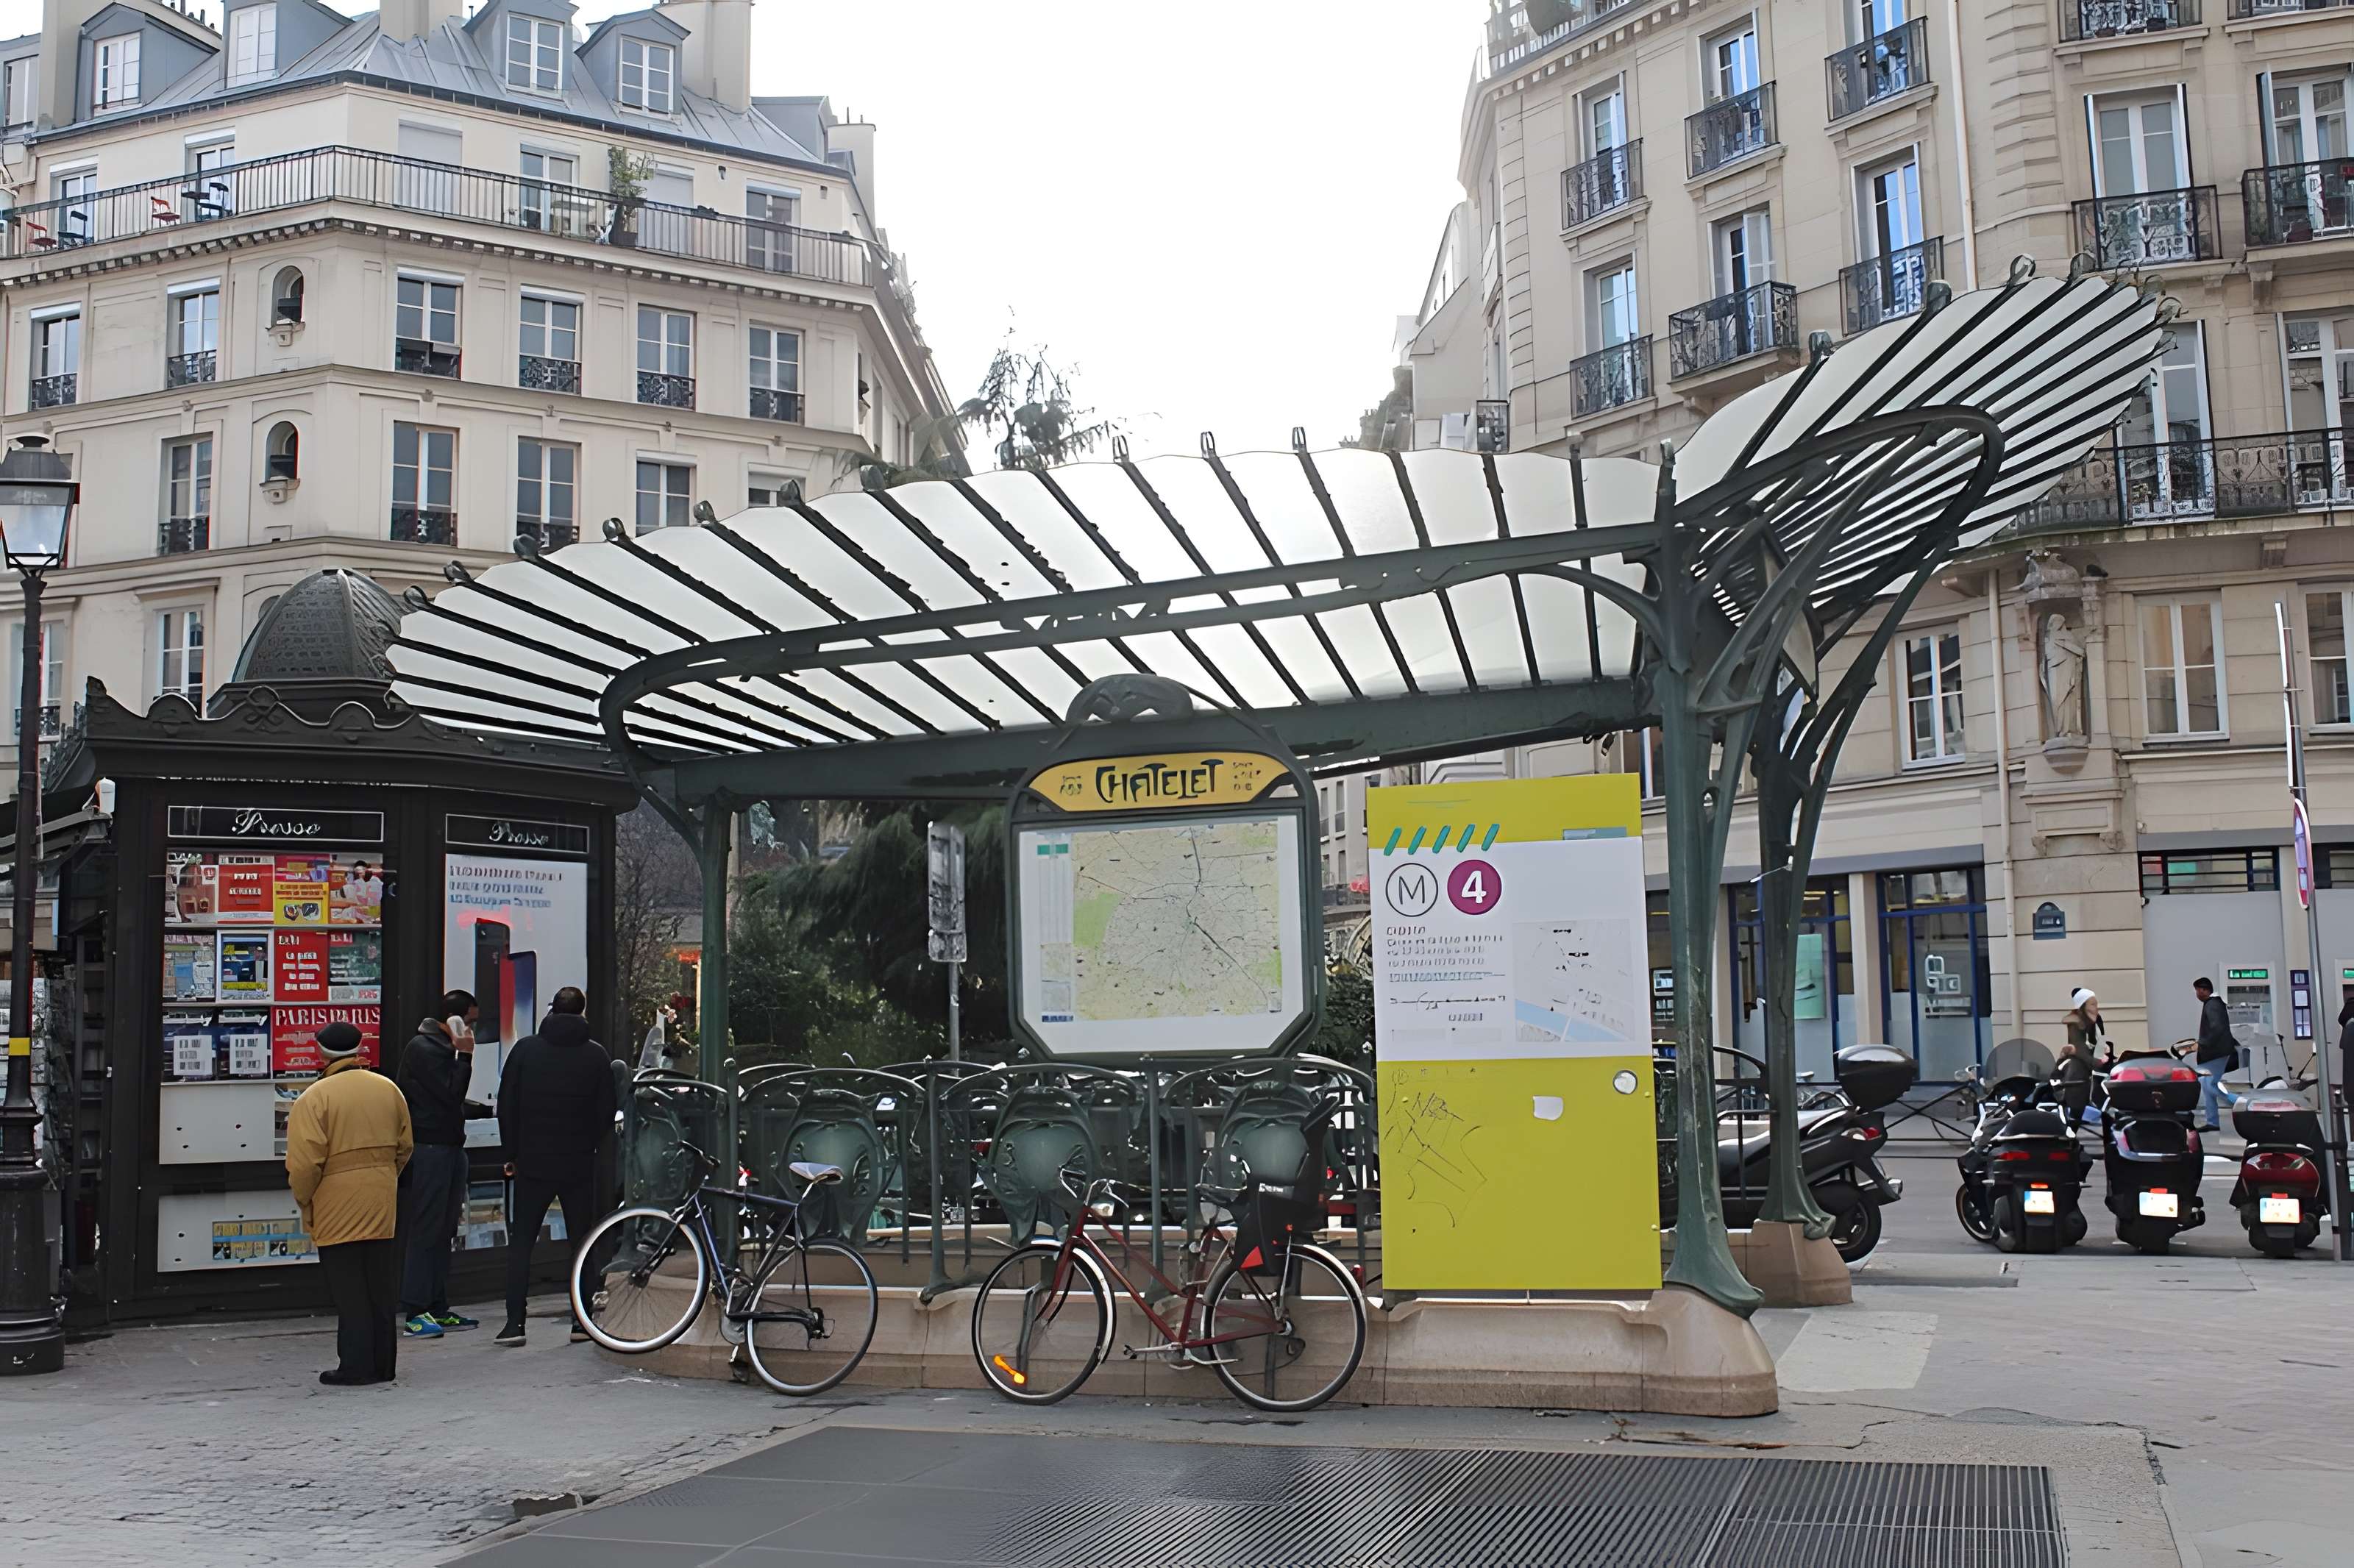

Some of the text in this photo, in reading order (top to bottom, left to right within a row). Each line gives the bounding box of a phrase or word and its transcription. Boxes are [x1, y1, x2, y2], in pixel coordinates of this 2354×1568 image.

[1095, 758, 1224, 803] CHATELET
[1398, 870, 1487, 905] M 4
